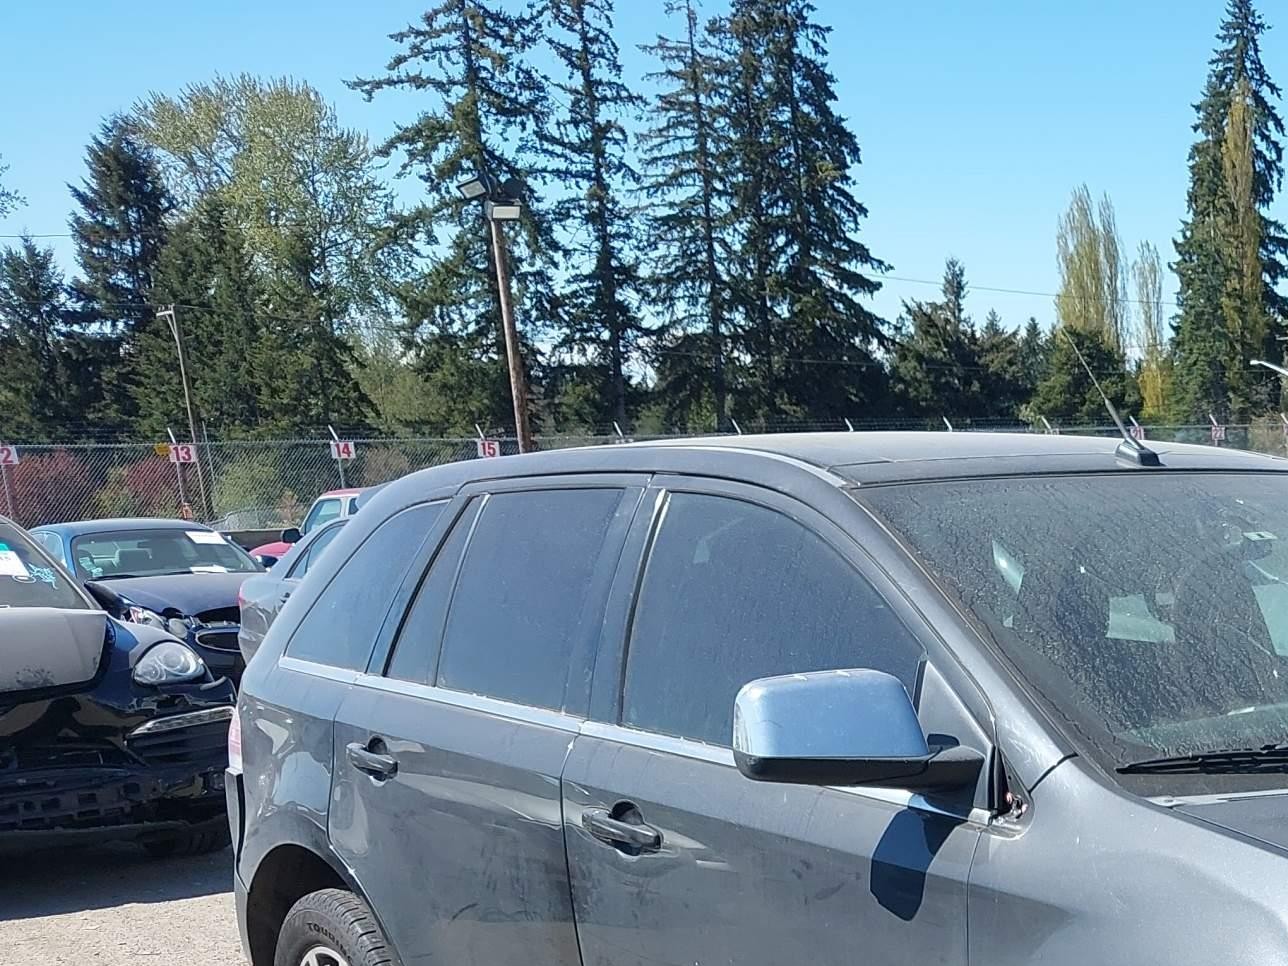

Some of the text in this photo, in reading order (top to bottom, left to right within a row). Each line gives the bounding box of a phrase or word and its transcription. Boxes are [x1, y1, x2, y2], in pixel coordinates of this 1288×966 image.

[172, 446, 192, 462] 13
[335, 443, 351, 458] 14
[481, 442, 496, 457] 15
